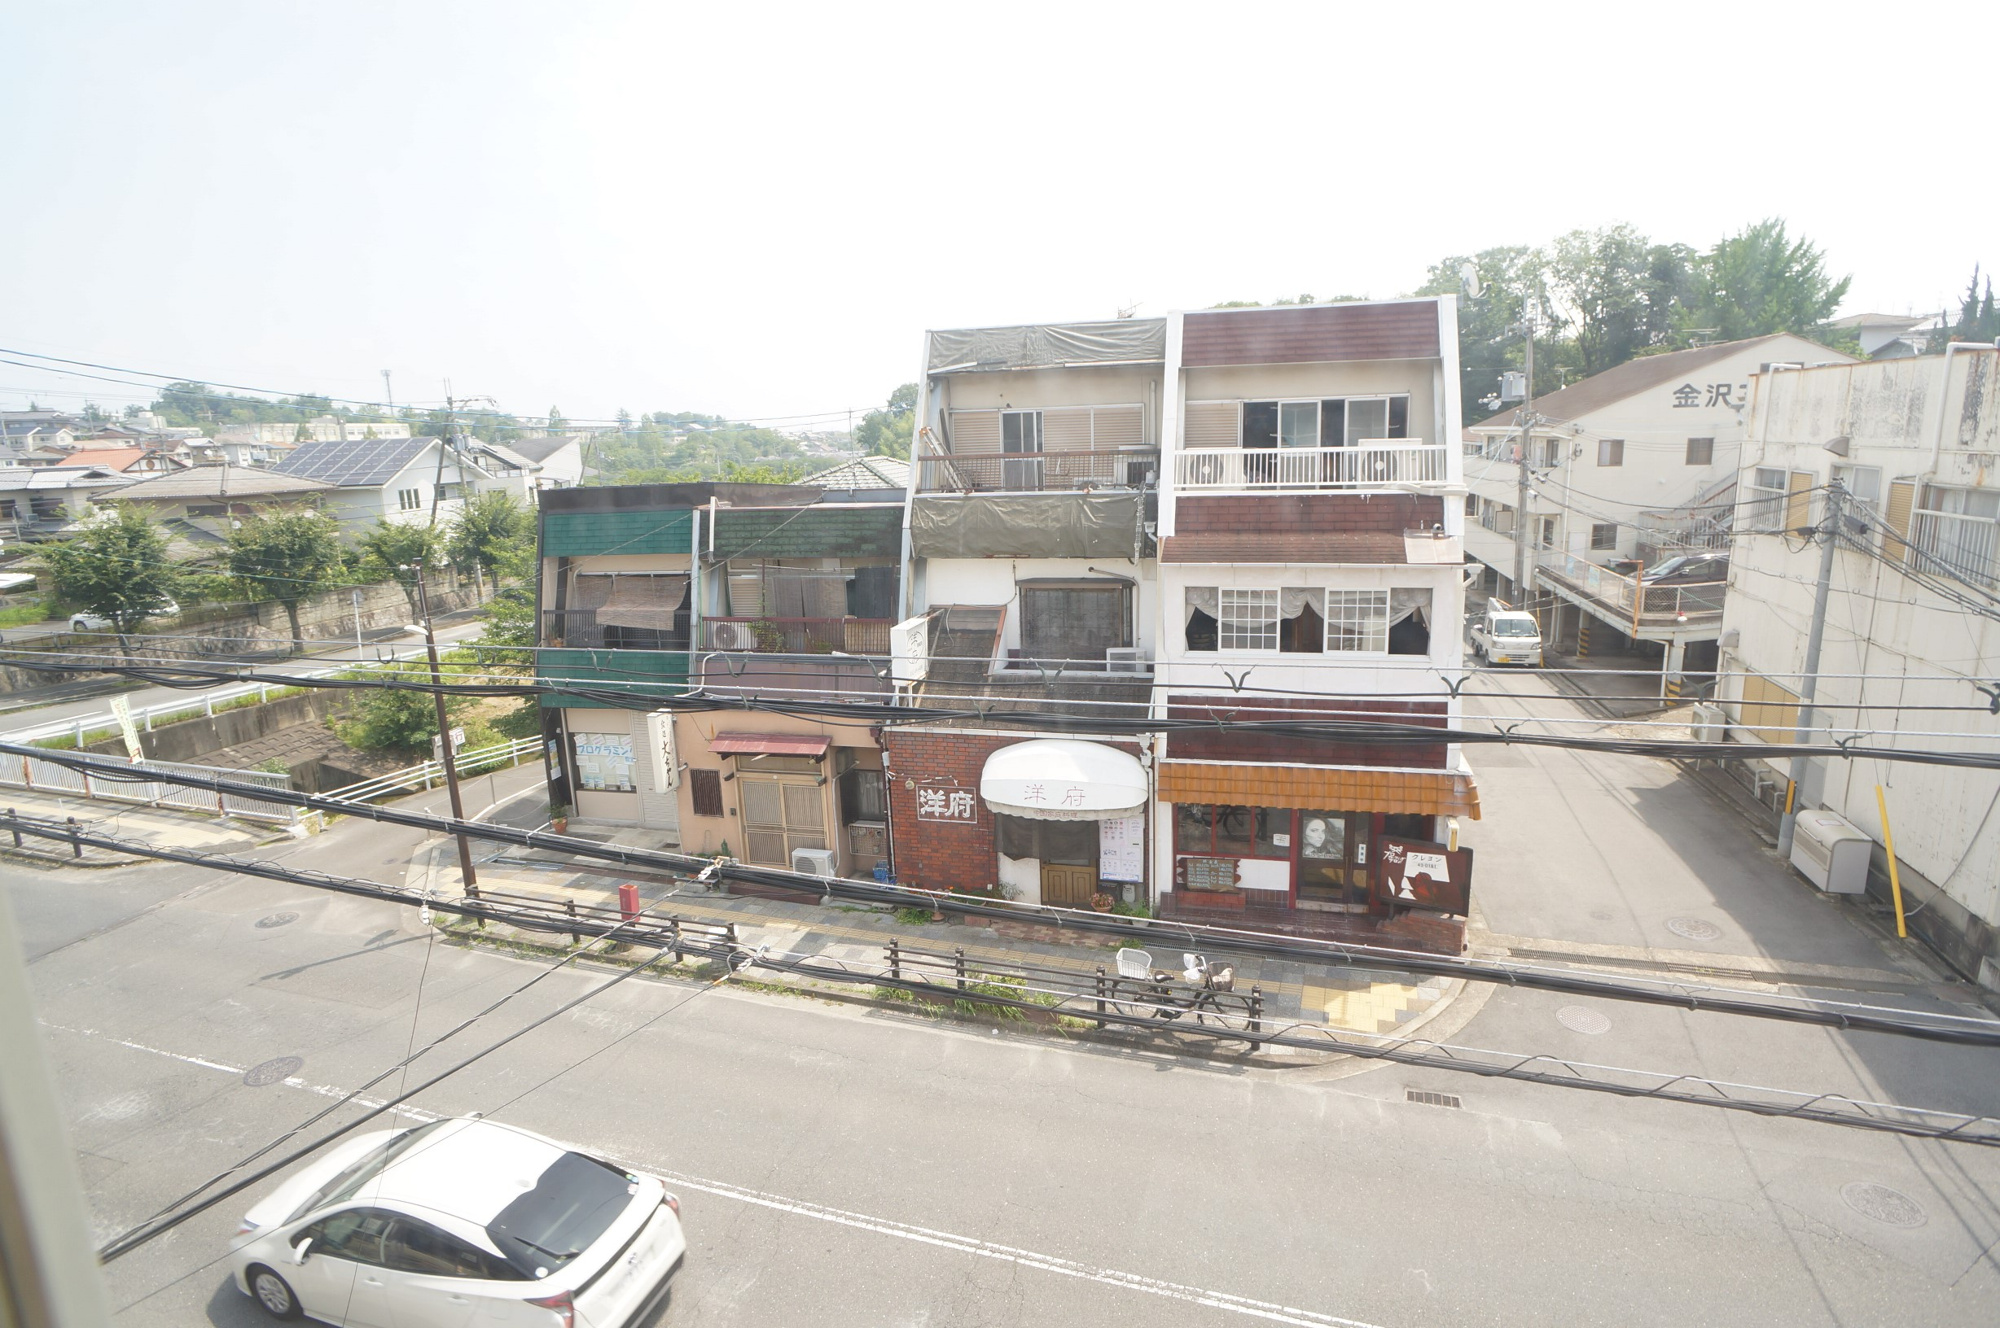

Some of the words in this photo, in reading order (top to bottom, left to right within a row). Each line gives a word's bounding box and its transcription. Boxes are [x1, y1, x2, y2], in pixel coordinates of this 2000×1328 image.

[577, 745, 633, 756] プログラミン
[919, 789, 975, 818] 洋府
[1024, 784, 1086, 806] 洋府
